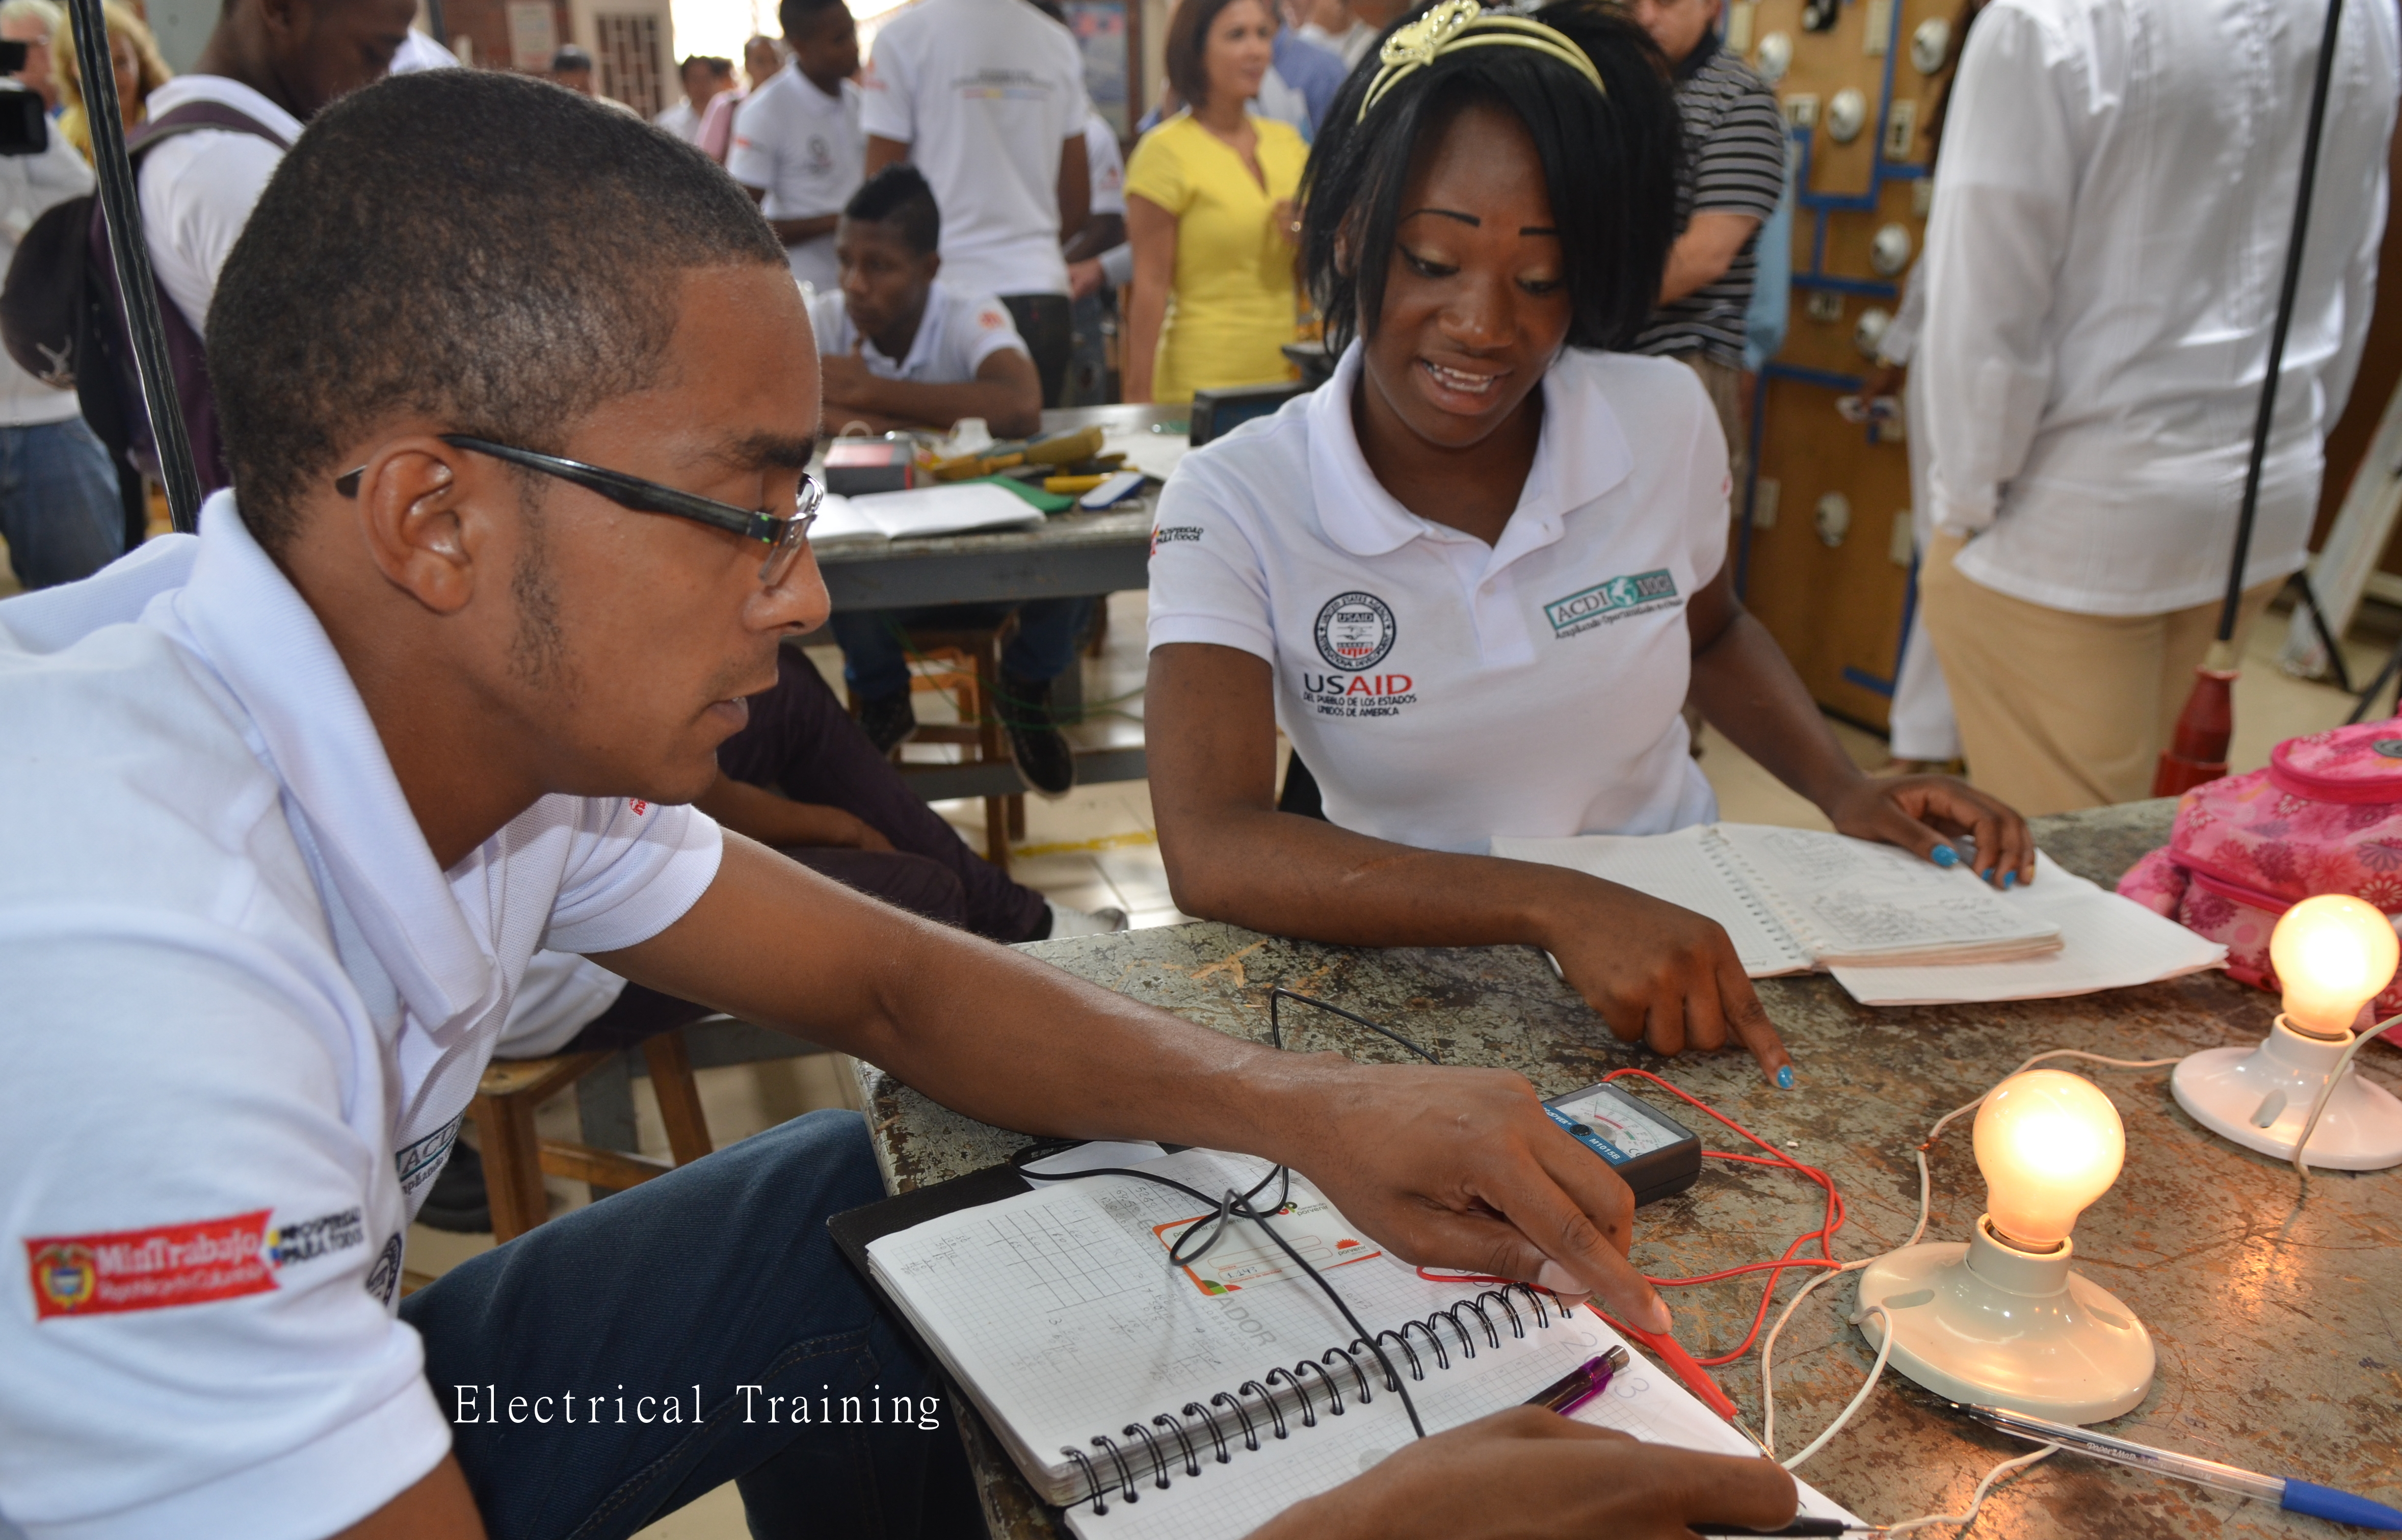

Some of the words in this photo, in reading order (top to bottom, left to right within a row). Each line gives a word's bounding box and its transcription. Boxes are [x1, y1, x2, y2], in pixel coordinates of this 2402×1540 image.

[1557, 590, 1608, 622] ACDI
[1338, 613, 1373, 622] USAID
[1304, 673, 1413, 696] USAID
[1303, 692, 1314, 702] DEL
[1317, 695, 1345, 705] PUEBLO
[1348, 697, 1358, 706] DE
[1360, 697, 1376, 706] LOS
[1378, 694, 1417, 706] ESTADOS
[1317, 705, 1344, 716] UNIDOS
[1346, 707, 1357, 717] DE
[1359, 706, 1399, 717] AMERICA
[1589, 1137, 1621, 1160] M1015B
[1297, 1205, 1328, 1216] porvenir
[96, 1228, 257, 1273] MinTrabajo
[1338, 1245, 1366, 1256] porvenir
[1202, 1305, 1251, 1351] COBRANZAS
[1560, 1331, 1650, 1399] 23
[2087, 1442, 2114, 1454] Paper
[2116, 1449, 2137, 1461] Mate
